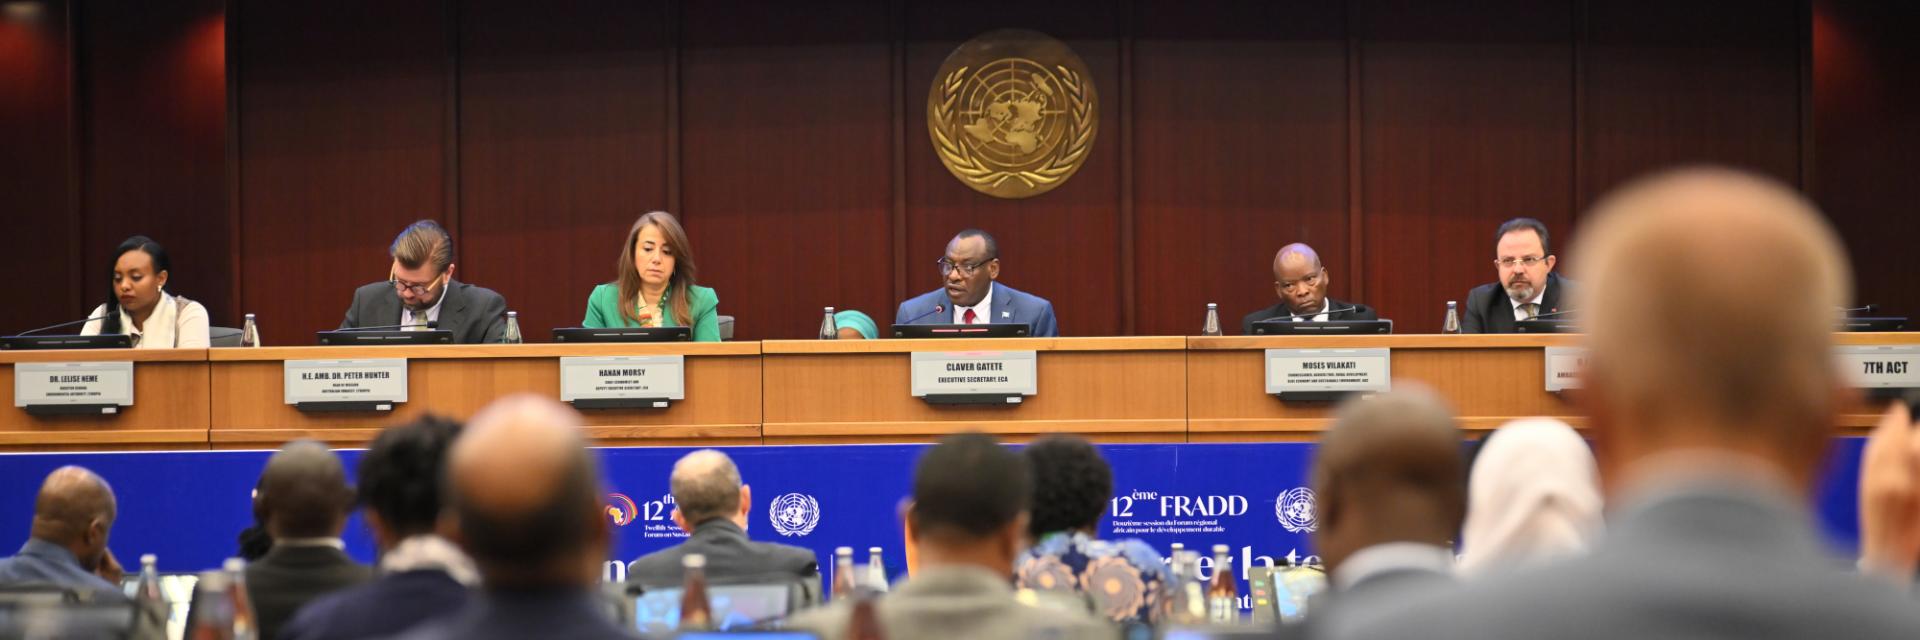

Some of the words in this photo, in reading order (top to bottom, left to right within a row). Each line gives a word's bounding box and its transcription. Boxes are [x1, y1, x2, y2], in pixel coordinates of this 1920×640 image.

[946, 363, 975, 371] CLAVER
[976, 362, 1003, 371] GATETE
[1863, 361, 1883, 374] 7TH
[1886, 361, 1908, 374] ACT
[599, 369, 621, 377] HANAN
[49, 375, 59, 383] DR.
[1160, 495, 1249, 517] FRADD
